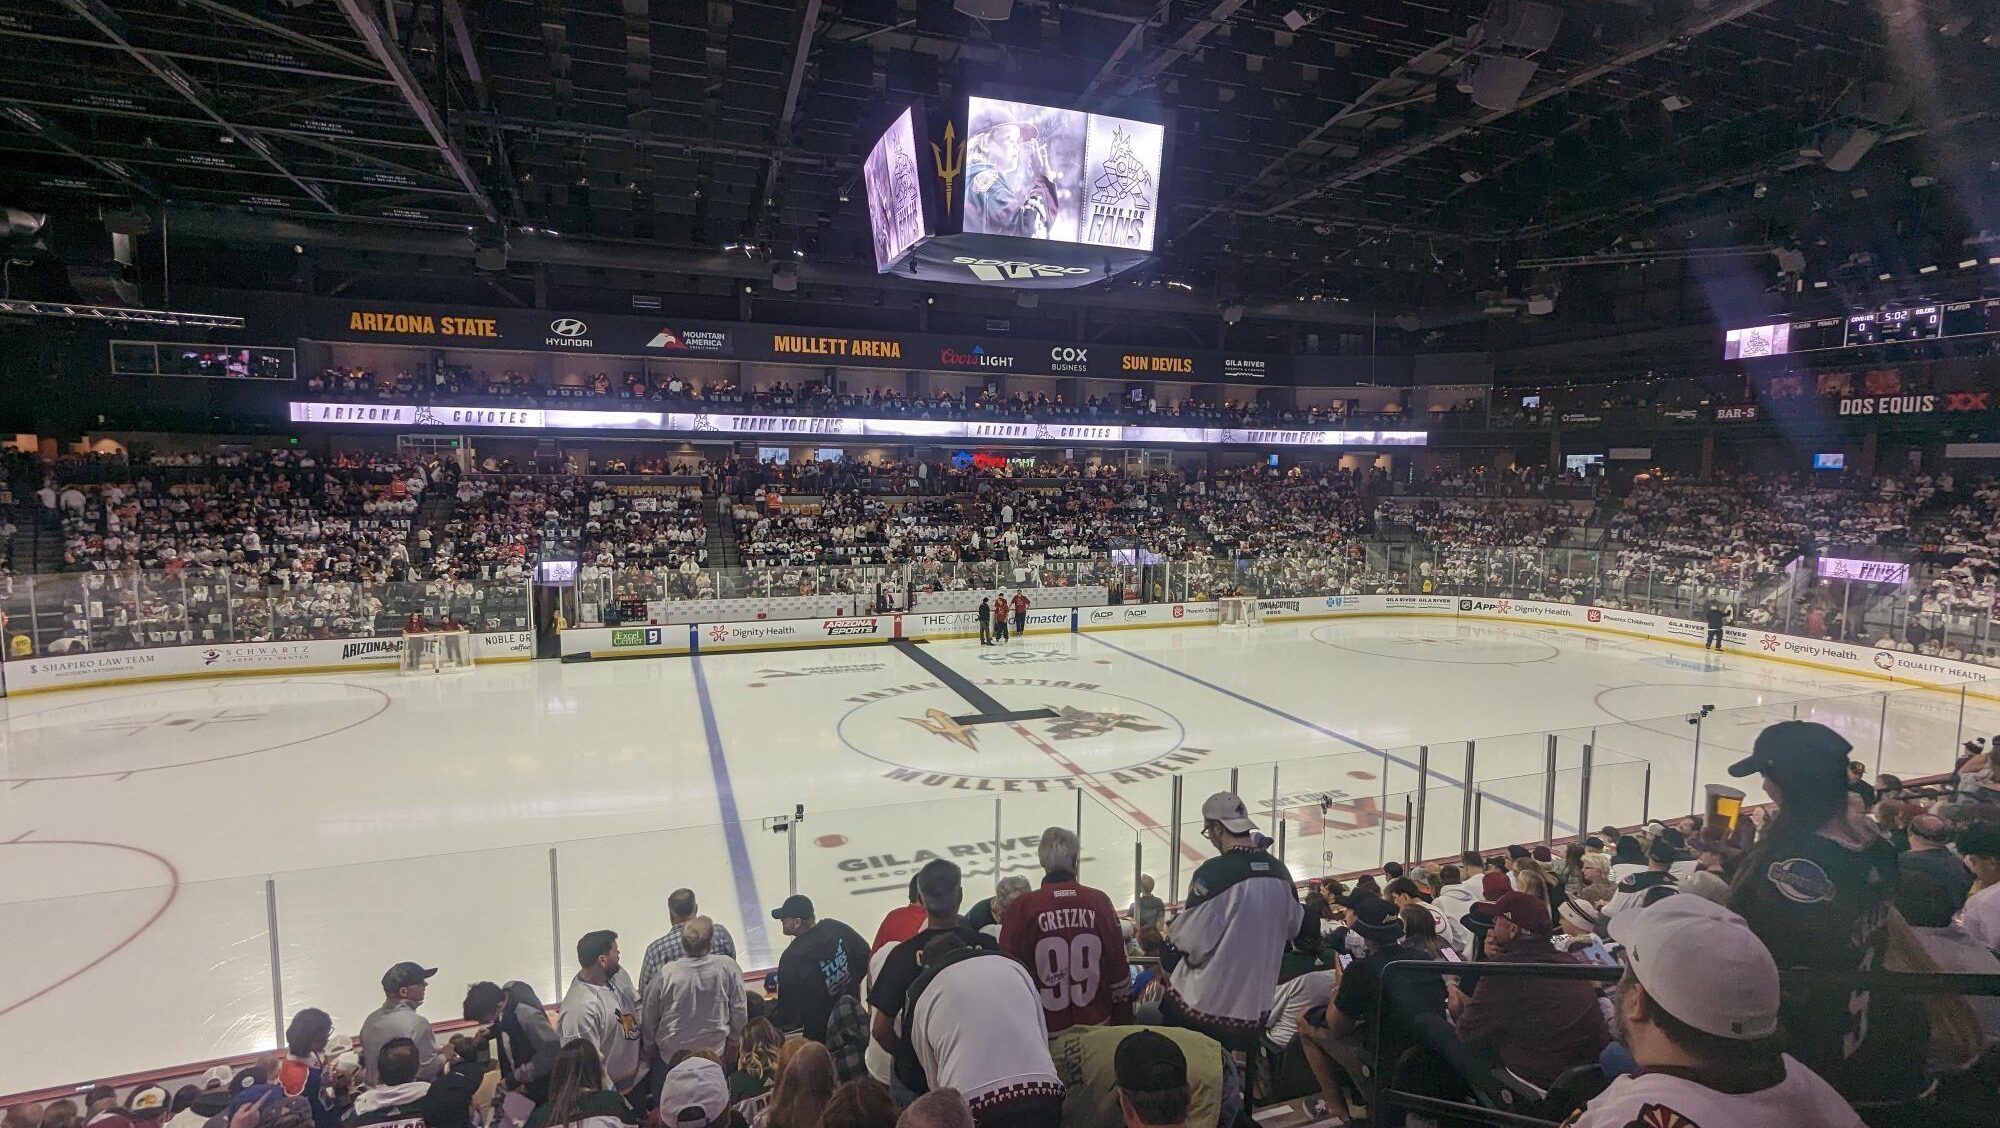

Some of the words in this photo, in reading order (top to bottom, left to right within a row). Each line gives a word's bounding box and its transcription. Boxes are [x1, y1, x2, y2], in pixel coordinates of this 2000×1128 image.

[1094, 205, 1124, 217] THANK
[1128, 209, 1145, 219] YOU
[1088, 213, 1144, 246] FANS
[1885, 310, 1908, 321] 5:02
[1929, 314, 1937, 324] 0
[350, 311, 436, 334] ARIZONA
[440, 316, 498, 337] STATE
[1858, 323, 1866, 332] 0
[682, 331, 725, 340] MOUNTAIN
[545, 337, 593, 348] HYUNDAI
[685, 338, 722, 347] AMERICA
[774, 335, 848, 355] MULLETT
[851, 340, 901, 358] ARENA
[940, 348, 980, 366] Coors
[980, 355, 1014, 367] LIGHT
[1051, 347, 1088, 362] COX
[1051, 363, 1087, 372] BUSINESS
[1122, 356, 1149, 370] SUN
[1151, 357, 1193, 373] DEVILS
[1225, 359, 1243, 367] GILA
[1243, 360, 1265, 368] RIVER
[1839, 398, 1874, 415] DOS
[1878, 395, 1936, 413] EQUIS
[1946, 392, 1988, 411] XX
[322, 406, 401, 421] ARIZONA
[453, 410, 528, 424] COYOTES
[1717, 407, 1756, 419] BAR-S
[732, 417, 777, 431] THANK
[780, 418, 807, 432] YOU
[809, 418, 844, 434] FANS
[976, 425, 1029, 437] ARIZONA
[1060, 427, 1112, 438] COYOTES
[1247, 431, 1278, 443] THANK
[1279, 432, 1299, 443] YOU
[1514, 604, 1543, 617] Dignity
[1545, 606, 1571, 617] Health
[825, 618, 876, 629] ARIZONA
[1684, 622, 1705, 631] RIVER
[616, 630, 640, 640] Excel
[732, 627, 765, 639] Dignity
[766, 625, 795, 636] Health
[830, 627, 874, 636] SPORTS
[1725, 629, 1748, 638] RIVER
[485, 634, 516, 646] NOBLE
[226, 645, 309, 656] SCHWARTZ
[342, 640, 388, 660] ARIZONA
[978, 649, 1068, 661] COX
[1784, 641, 1821, 659] Dignity
[1822, 647, 1858, 661] Health
[42, 659, 96, 674] SHAPIRO
[98, 656, 123, 668] LAW
[125, 655, 155, 665] TEAM
[1897, 659, 1946, 675] EQUALITY
[1948, 668, 1987, 683] HEALTH
[882, 767, 1078, 793] MULLETT
[1109, 746, 1211, 785] ARENA
[837, 848, 942, 872] GILA
[947, 834, 1041, 859] RIVE
[1038, 907, 1097, 933] GRETZKY
[1034, 933, 1103, 1012] 99
